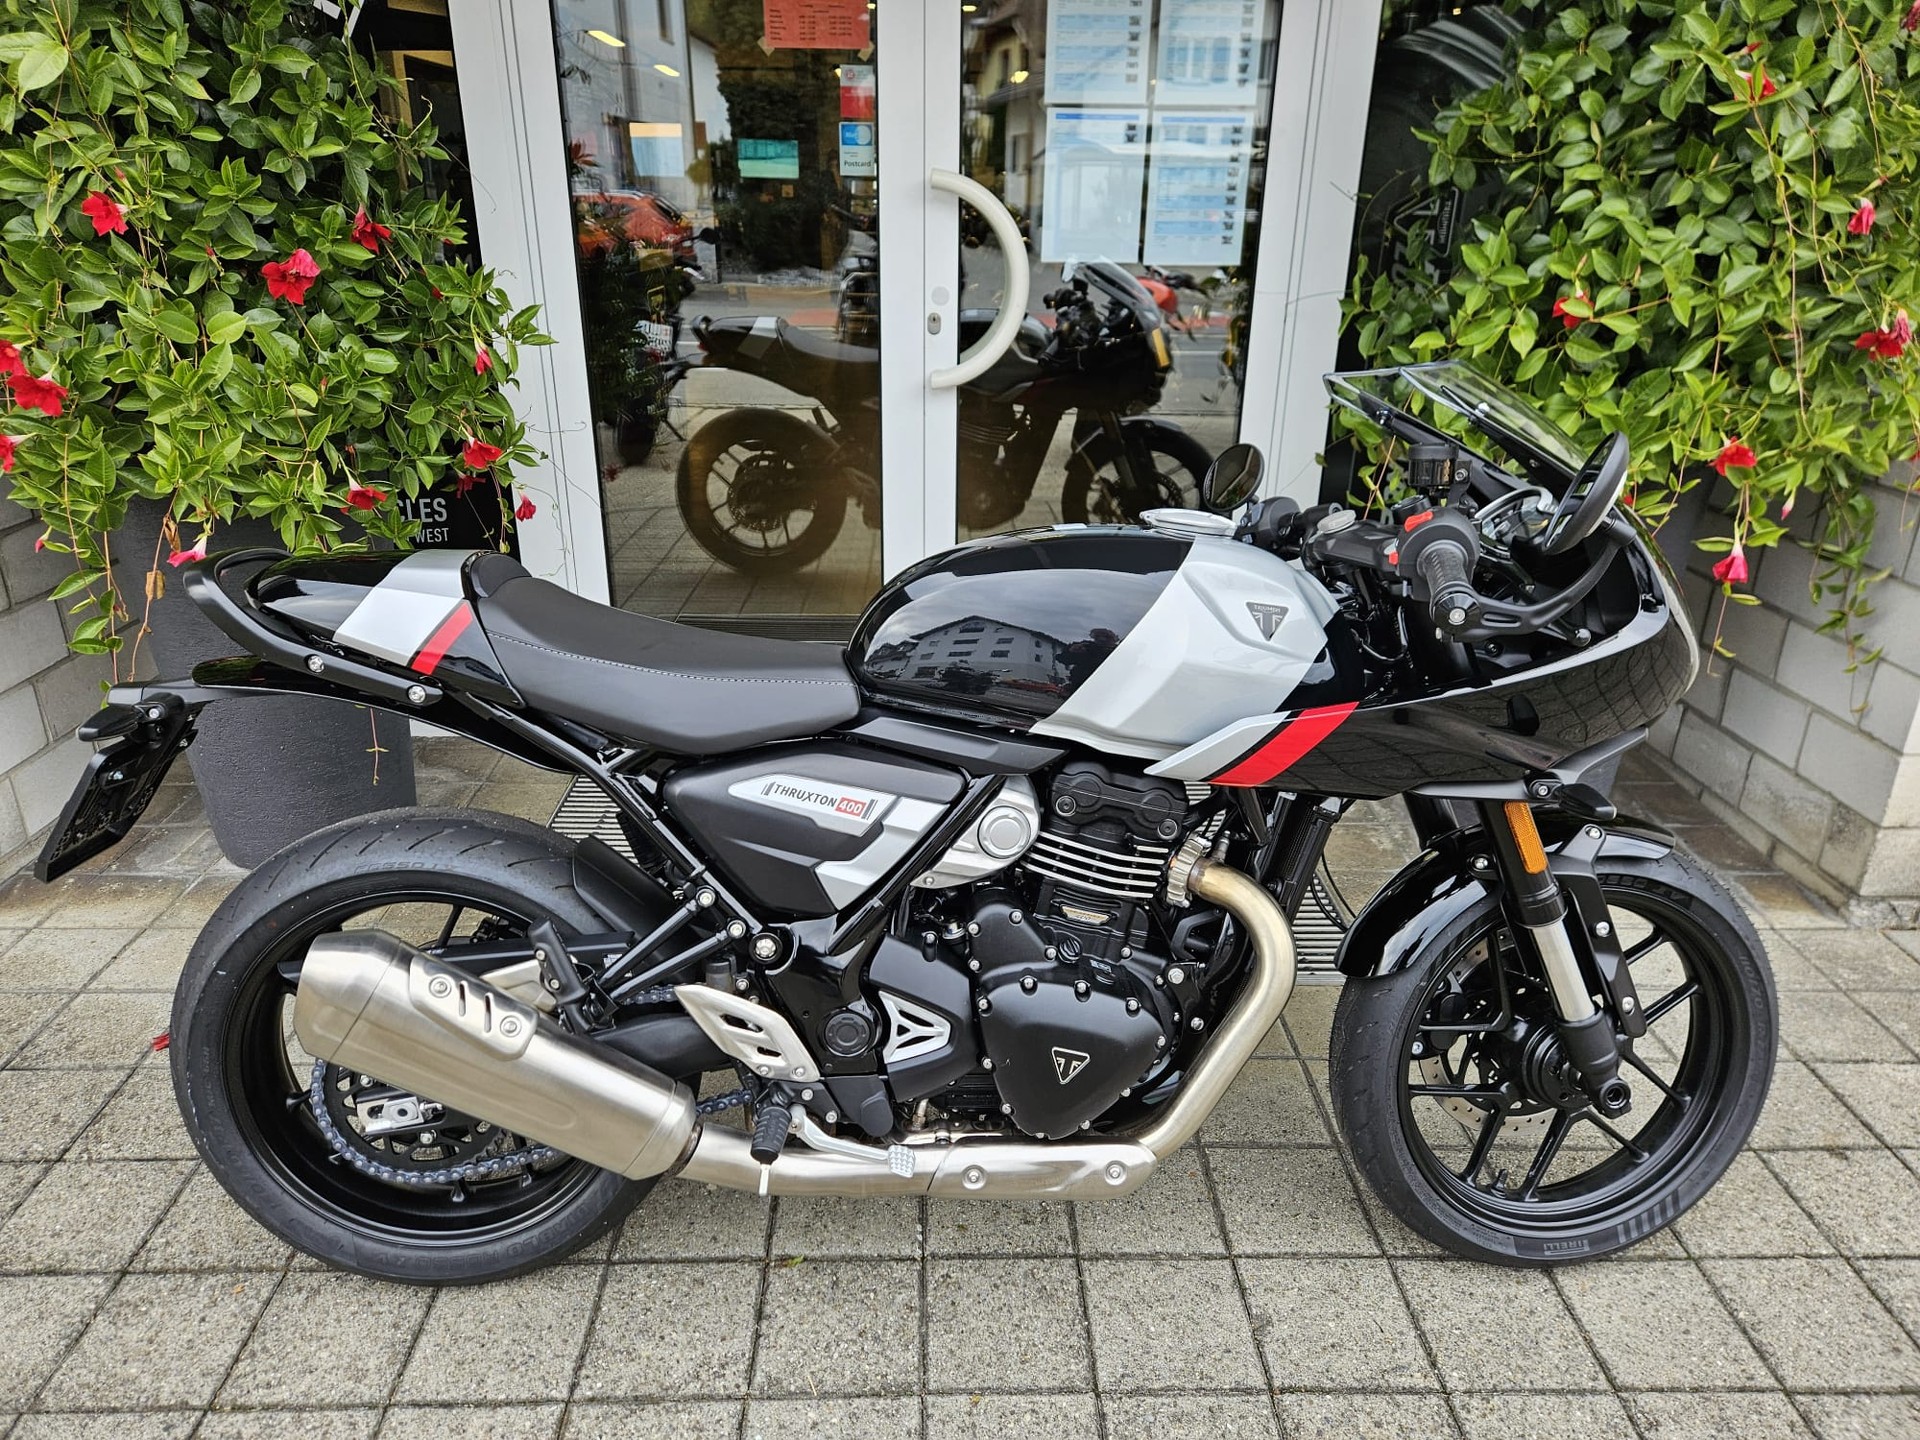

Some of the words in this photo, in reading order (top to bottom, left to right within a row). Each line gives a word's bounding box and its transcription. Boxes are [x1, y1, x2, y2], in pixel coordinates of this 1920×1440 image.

[843, 159, 872, 168] Postcard
[415, 527, 449, 543] WEST
[773, 783, 838, 808] THRUXTON
[837, 798, 864, 815] 400
[1543, 1239, 1590, 1256] PIRELLI
